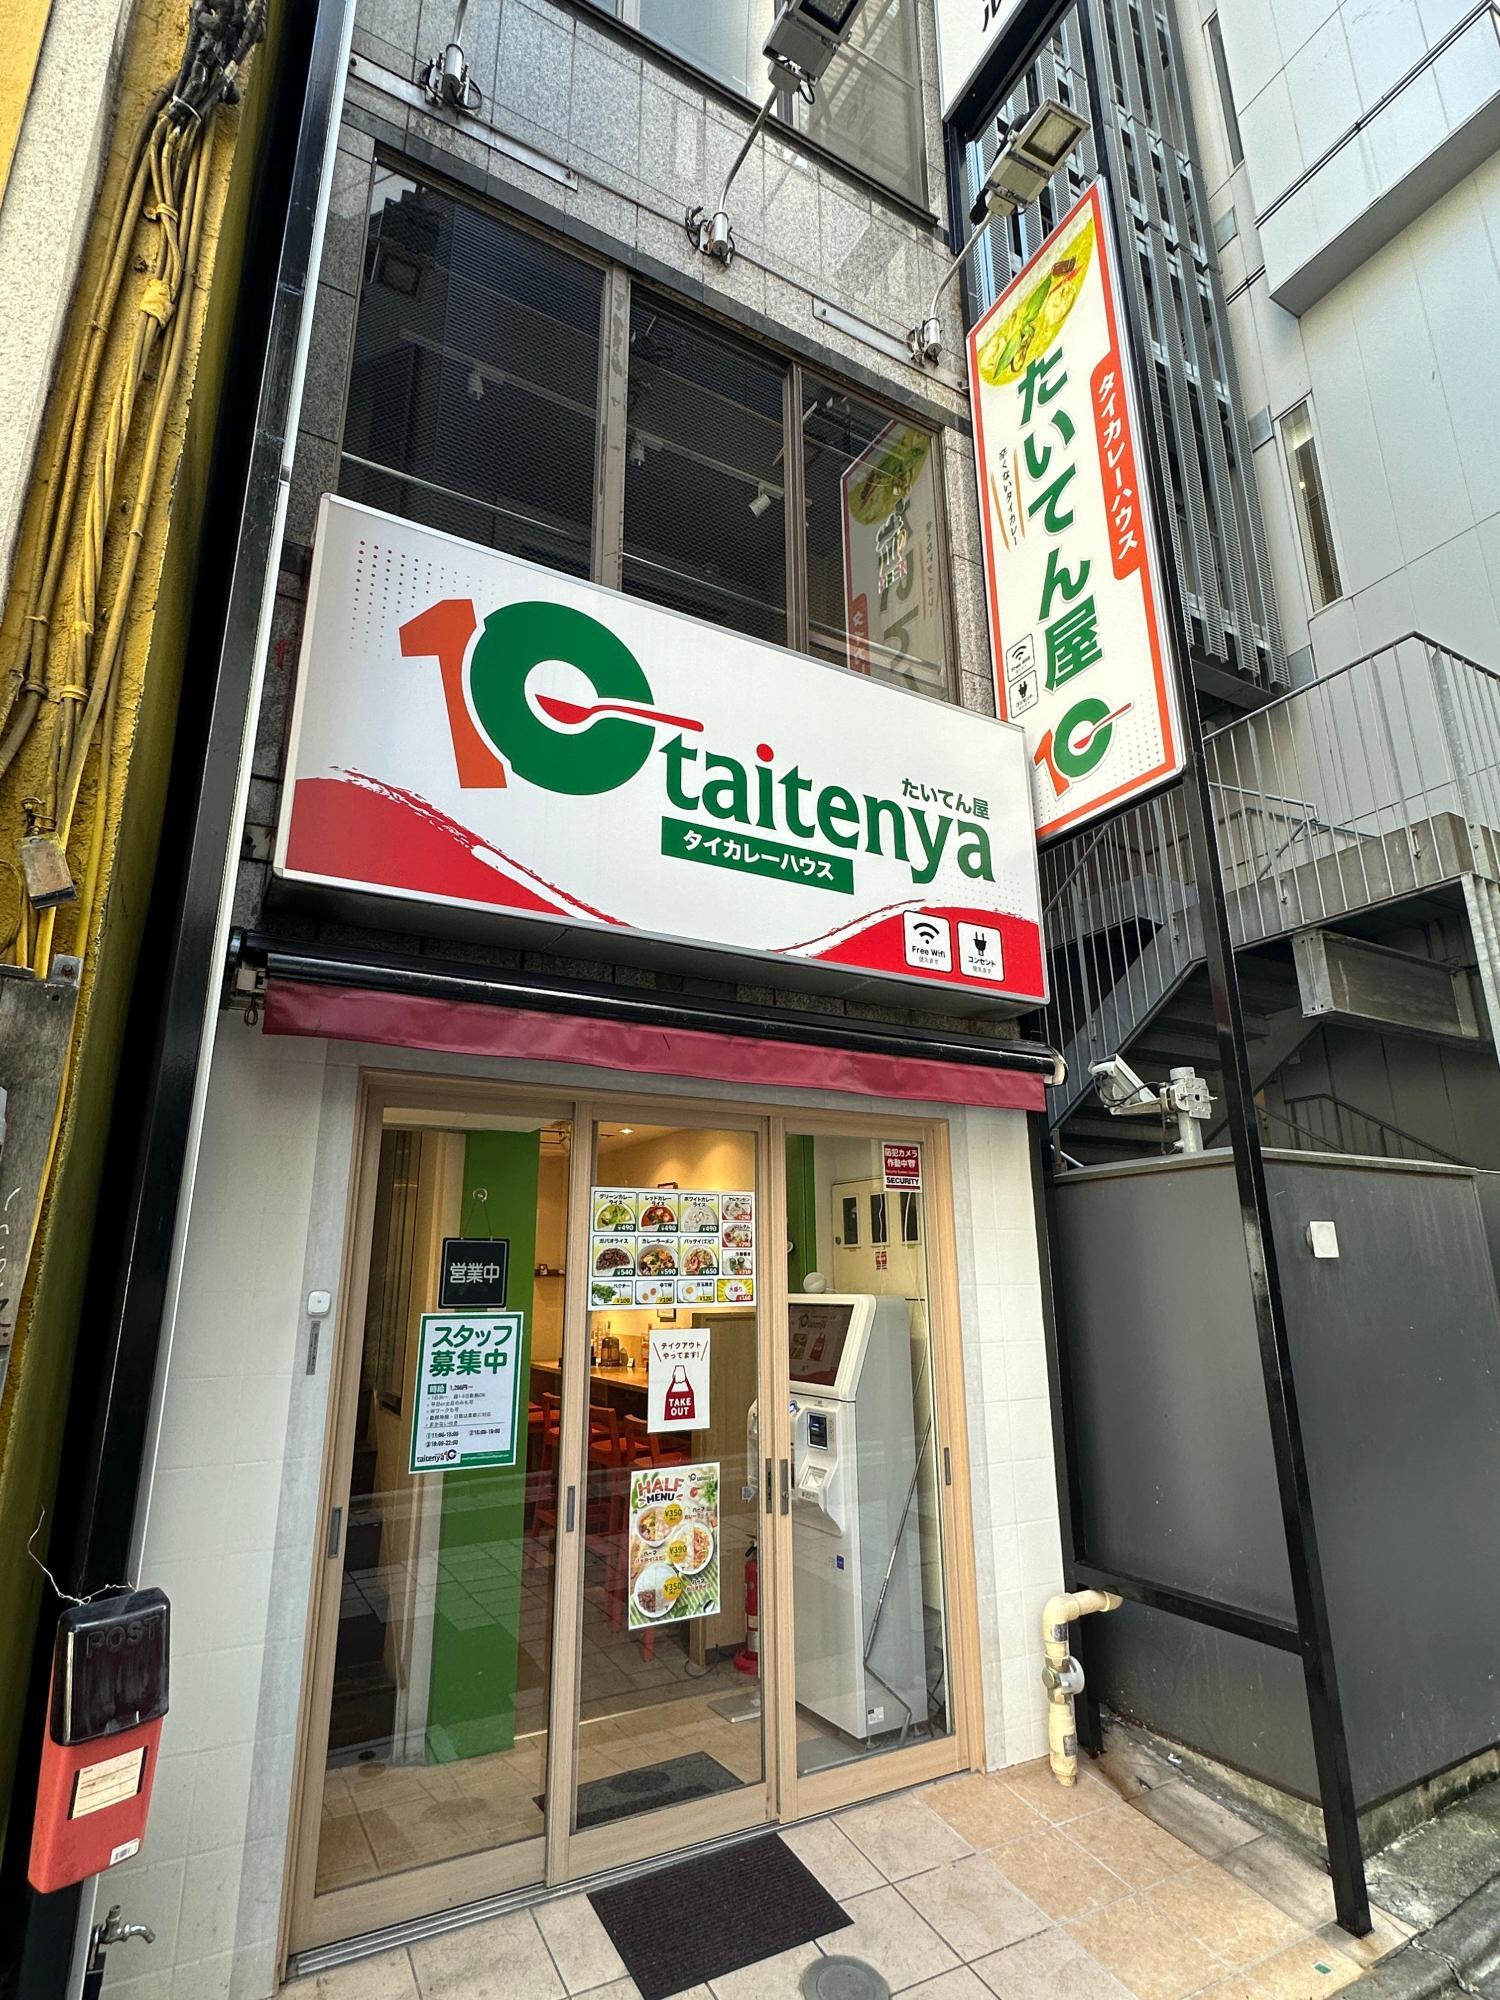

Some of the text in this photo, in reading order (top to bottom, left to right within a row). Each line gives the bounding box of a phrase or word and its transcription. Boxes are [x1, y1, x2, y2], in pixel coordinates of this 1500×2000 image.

[1098, 371, 1138, 560] タイカレーハウス
[1018, 347, 1102, 691] たいてん屋
[902, 778, 991, 820] たいてん屋
[658, 733, 996, 884] taitenya
[683, 830, 834, 881] タイカレーハウス
[912, 945, 946, 958] Free Wifi
[968, 955, 996, 968] コンセント
[885, 1148, 918, 1158] 防犯カメラ
[886, 1176, 919, 1185] SECURITY
[450, 1262, 499, 1284] 営業中
[432, 1324, 513, 1348] スタッフ
[661, 1342, 701, 1350] テイクアウト
[663, 1351, 700, 1359] やってます!
[429, 1348, 508, 1377] 募集中
[669, 1397, 691, 1407] TAKE
[670, 1407, 689, 1416] OUT
[637, 1477, 685, 1498] HALF
[646, 1492, 675, 1504] MENU
[664, 1508, 682, 1517] ¥350
[669, 1545, 687, 1554] ¥390
[664, 1582, 682, 1591] ¥350
[86, 1614, 161, 1657] POST
